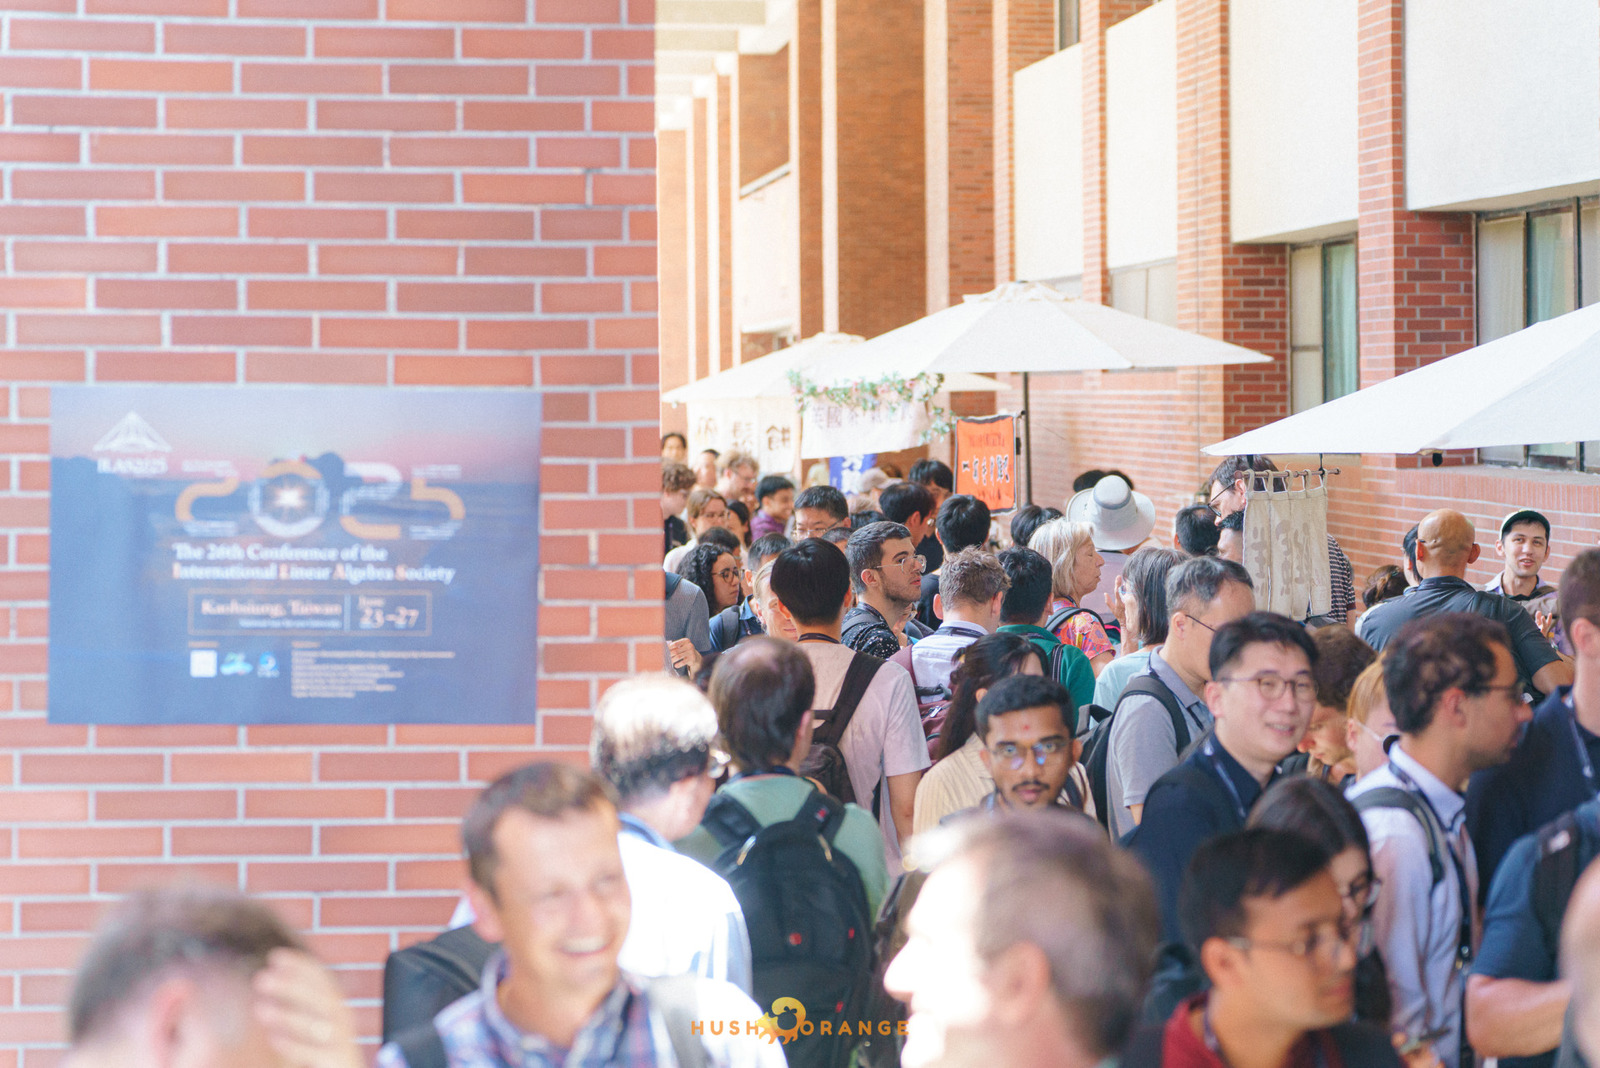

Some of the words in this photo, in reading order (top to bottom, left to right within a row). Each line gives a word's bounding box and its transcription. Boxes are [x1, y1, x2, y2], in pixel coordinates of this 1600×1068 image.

[172, 542, 205, 560] The
[246, 542, 339, 561] Conference
[340, 543, 360, 561] of
[360, 543, 388, 561] the
[172, 562, 278, 580] International
[332, 562, 394, 585] Algebra
[395, 562, 456, 585] Society
